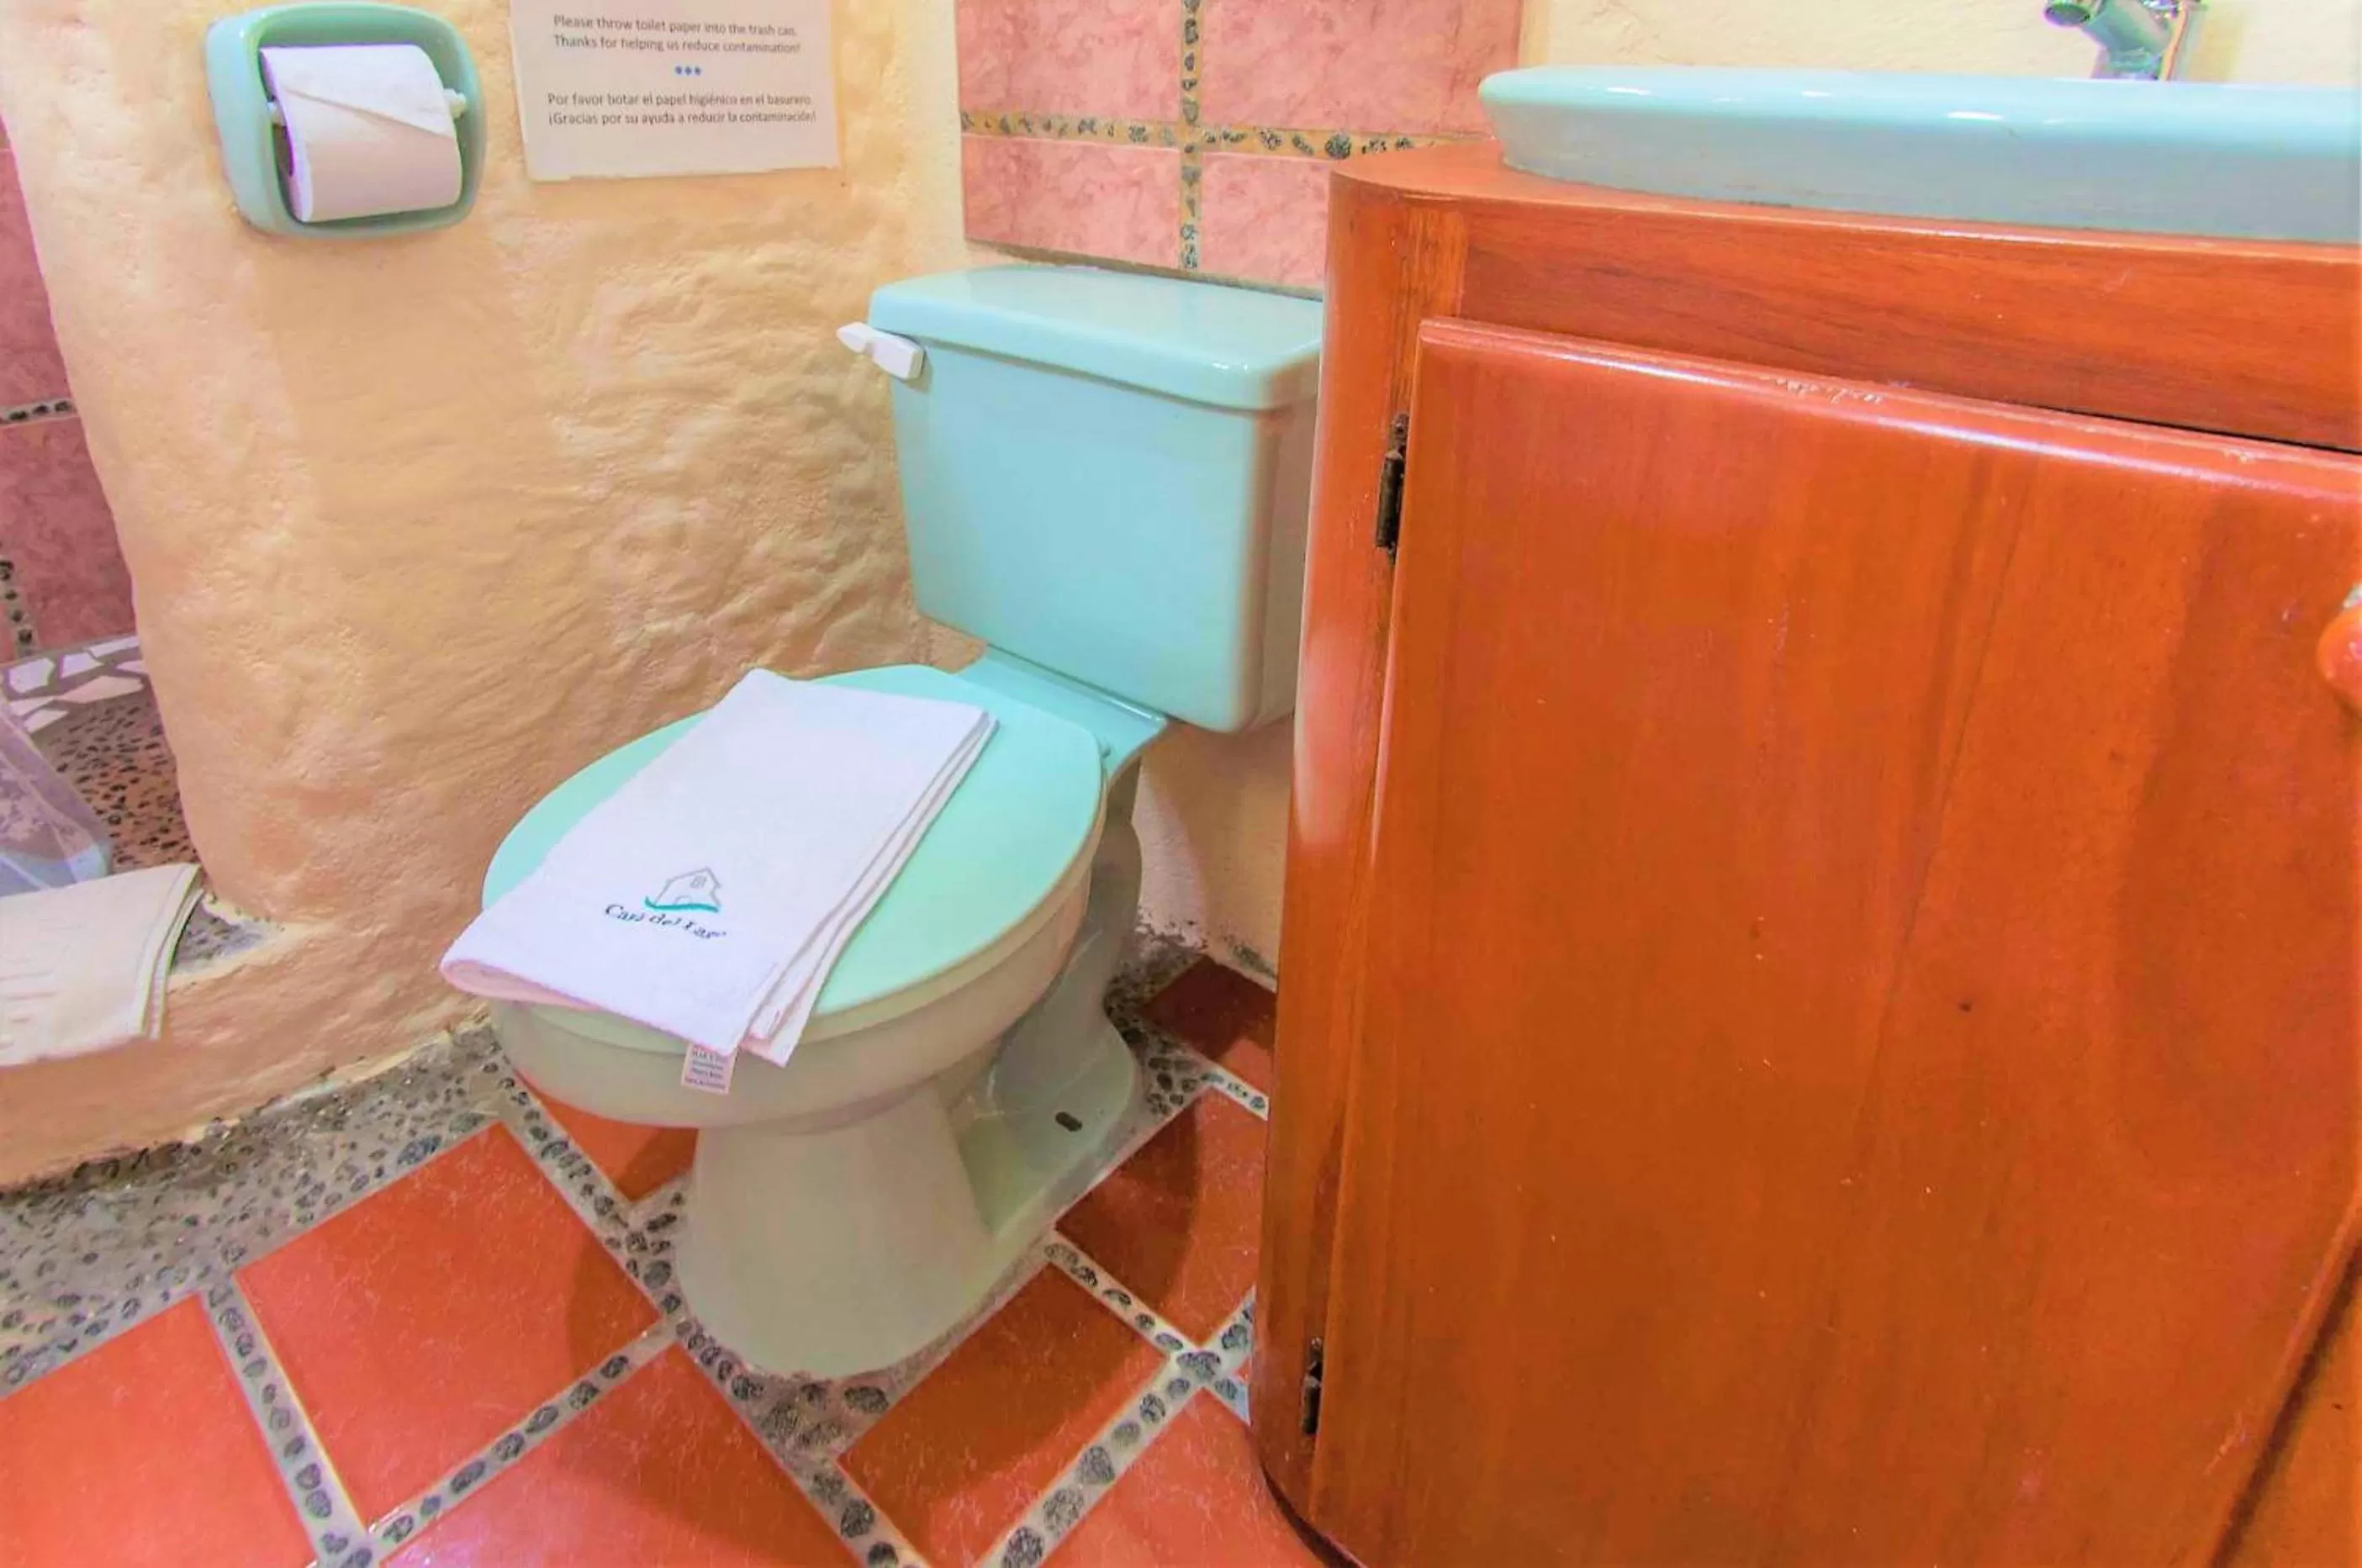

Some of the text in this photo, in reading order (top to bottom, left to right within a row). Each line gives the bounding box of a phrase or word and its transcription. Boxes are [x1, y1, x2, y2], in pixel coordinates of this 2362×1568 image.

[553, 14, 594, 29] Please
[595, 16, 632, 30] throw
[636, 18, 666, 32] toilet
[668, 22, 700, 34] paper
[704, 22, 726, 34] into
[728, 22, 746, 34] the
[748, 24, 775, 35] trash
[554, 34, 598, 48] Thanks
[600, 36, 616, 49] for
[621, 38, 663, 51] helping
[667, 40, 679, 50] us
[682, 40, 720, 51] reduce
[547, 92, 568, 105] Por
[572, 92, 603, 105] favor
[607, 92, 638, 106] botar
[642, 92, 653, 105] el
[656, 93, 686, 107] papel
[740, 95, 753, 105] en
[755, 93, 764, 105] el
[601, 114, 621, 126] por
[625, 114, 638, 124] su
[642, 112, 675, 125] ayuda
[678, 114, 685, 124] a
[687, 113, 726, 124] reducir
[727, 112, 737, 123] la
[648, 913, 682, 927] del
